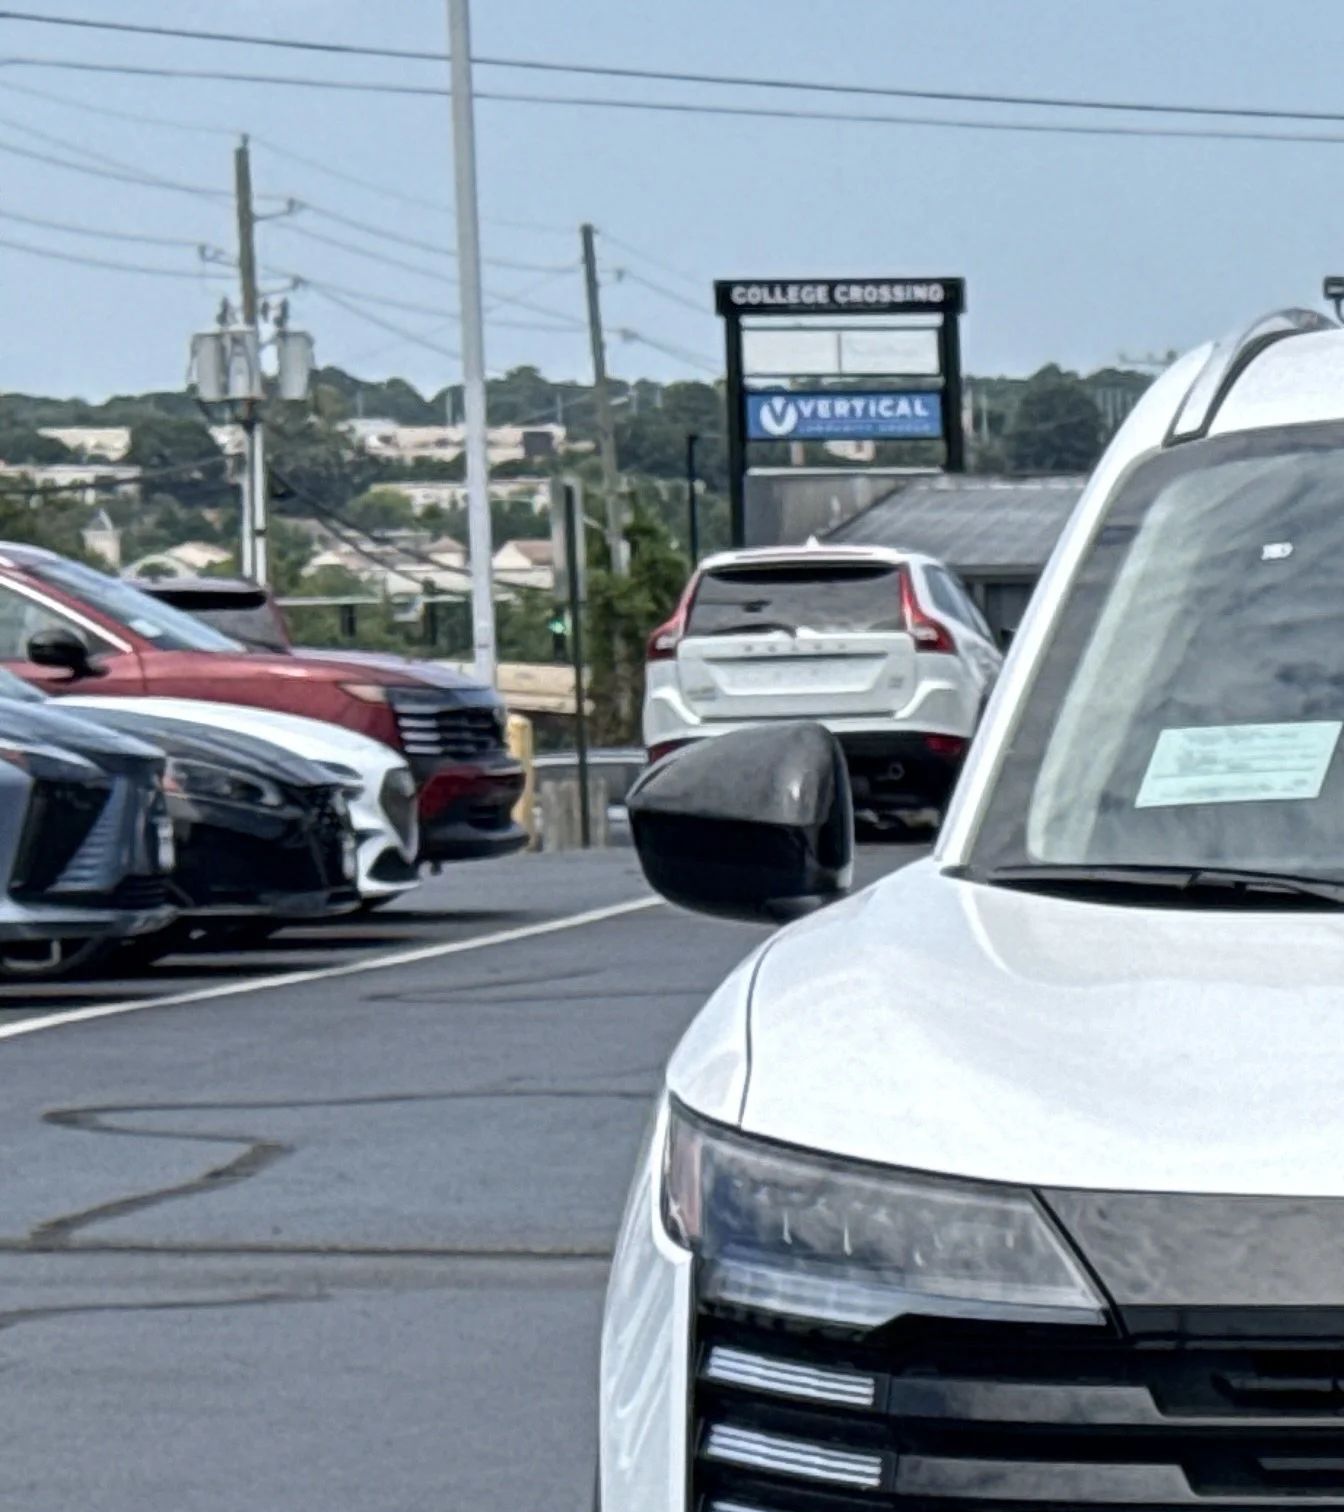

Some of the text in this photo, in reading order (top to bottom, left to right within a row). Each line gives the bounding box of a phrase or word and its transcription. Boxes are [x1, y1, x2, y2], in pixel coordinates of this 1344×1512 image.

[731, 283, 944, 305] COLLEGE CROSSING
[797, 398, 929, 419] VERTICAL
